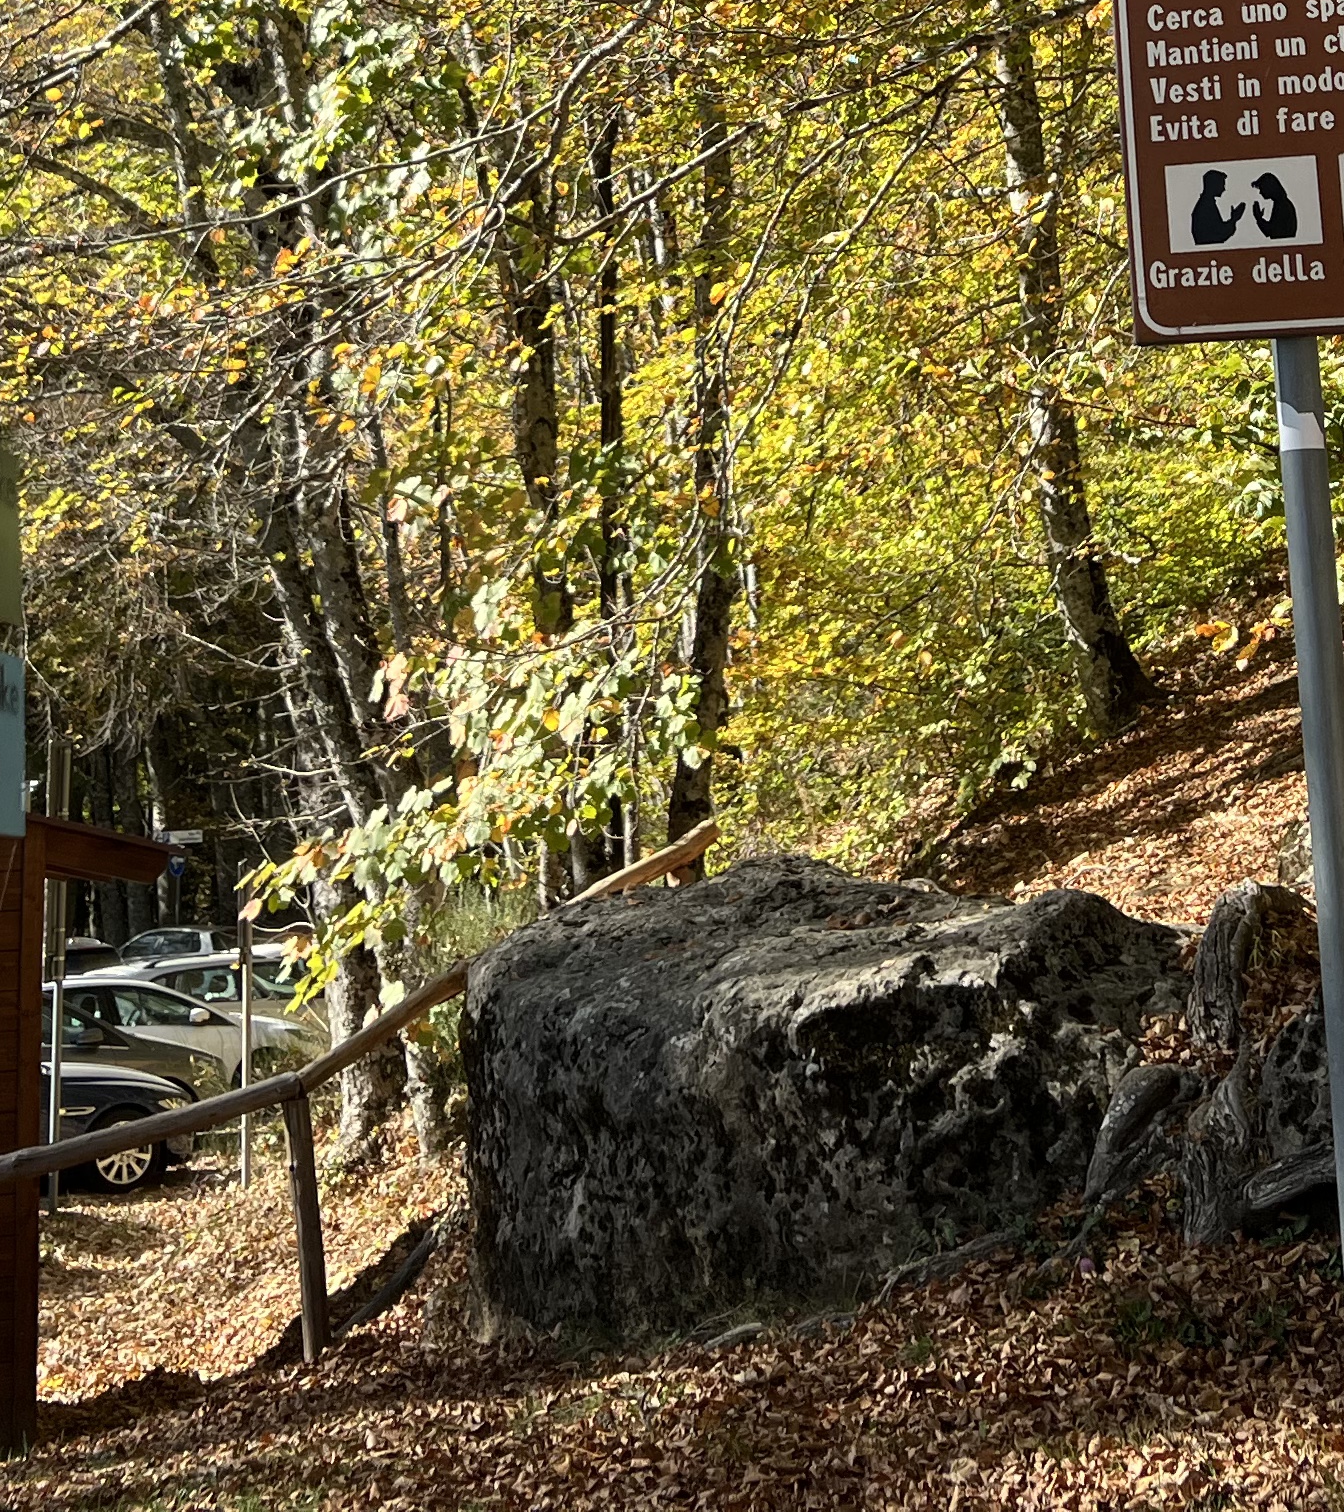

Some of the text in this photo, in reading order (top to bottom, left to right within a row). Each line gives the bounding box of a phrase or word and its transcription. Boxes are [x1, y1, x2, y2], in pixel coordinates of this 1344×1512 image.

[1147, 4, 1224, 32] Cerca
[1241, 2, 1287, 24] uno
[1146, 34, 1259, 68] Mantieni
[1275, 36, 1307, 58] un
[1149, 74, 1222, 104] Vesti
[1237, 72, 1261, 98] in
[1149, 114, 1219, 142] Evita
[1236, 109, 1260, 136] di
[1275, 107, 1335, 133] fare
[1149, 259, 1234, 289] Grazie
[1252, 253, 1326, 284] della
